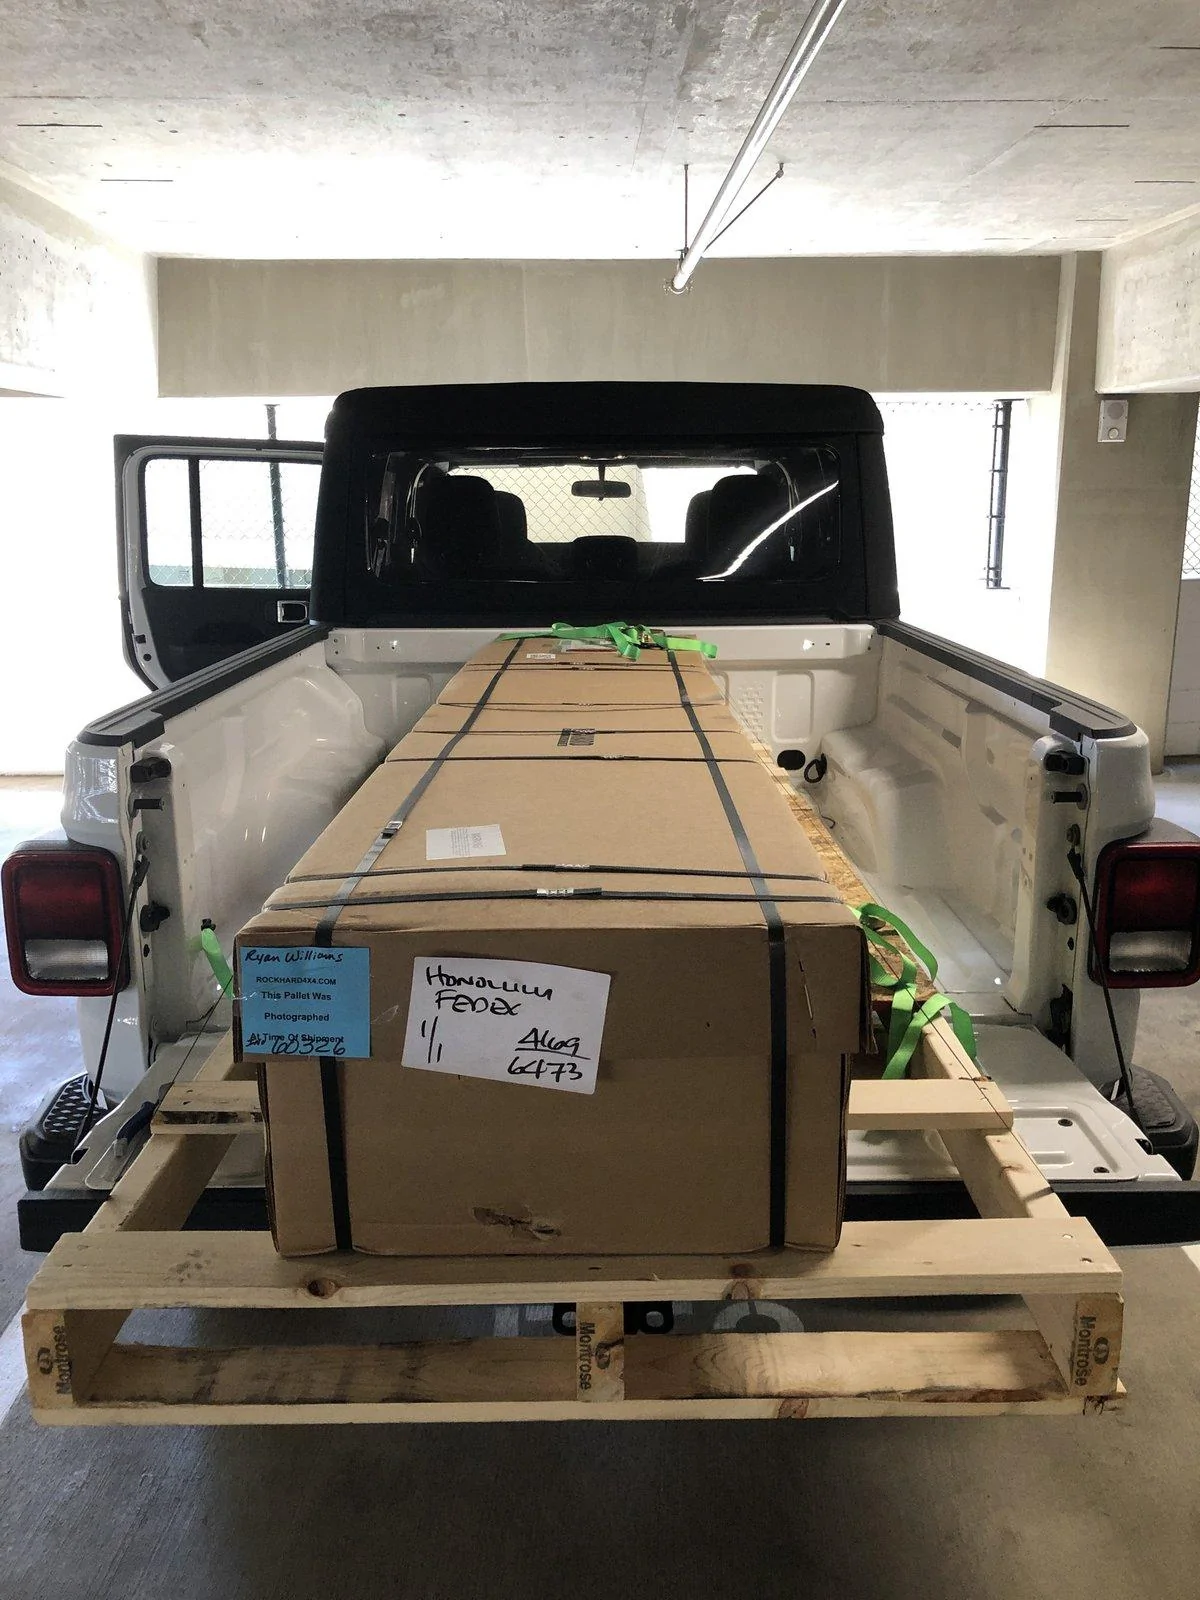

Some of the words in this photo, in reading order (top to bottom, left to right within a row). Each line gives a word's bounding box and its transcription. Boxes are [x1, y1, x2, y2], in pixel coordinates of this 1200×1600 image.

[244, 949, 281, 964] Ryan
[285, 950, 344, 963] Williams
[256, 976, 337, 986] ROCKHARD4X4.COM
[261, 991, 281, 999] This
[284, 991, 310, 1000] Pallet
[312, 991, 332, 1001] Was
[264, 1012, 330, 1022] Photographed
[262, 1033, 284, 1041] Time
[287, 1033, 299, 1041] Of
[301, 1033, 345, 1043] Shipment
[507, 1056, 583, 1083] 6473
[579, 1322, 596, 1391] Montrose
[1075, 1315, 1096, 1387] Montrose
[53, 1325, 72, 1394] Montrose
